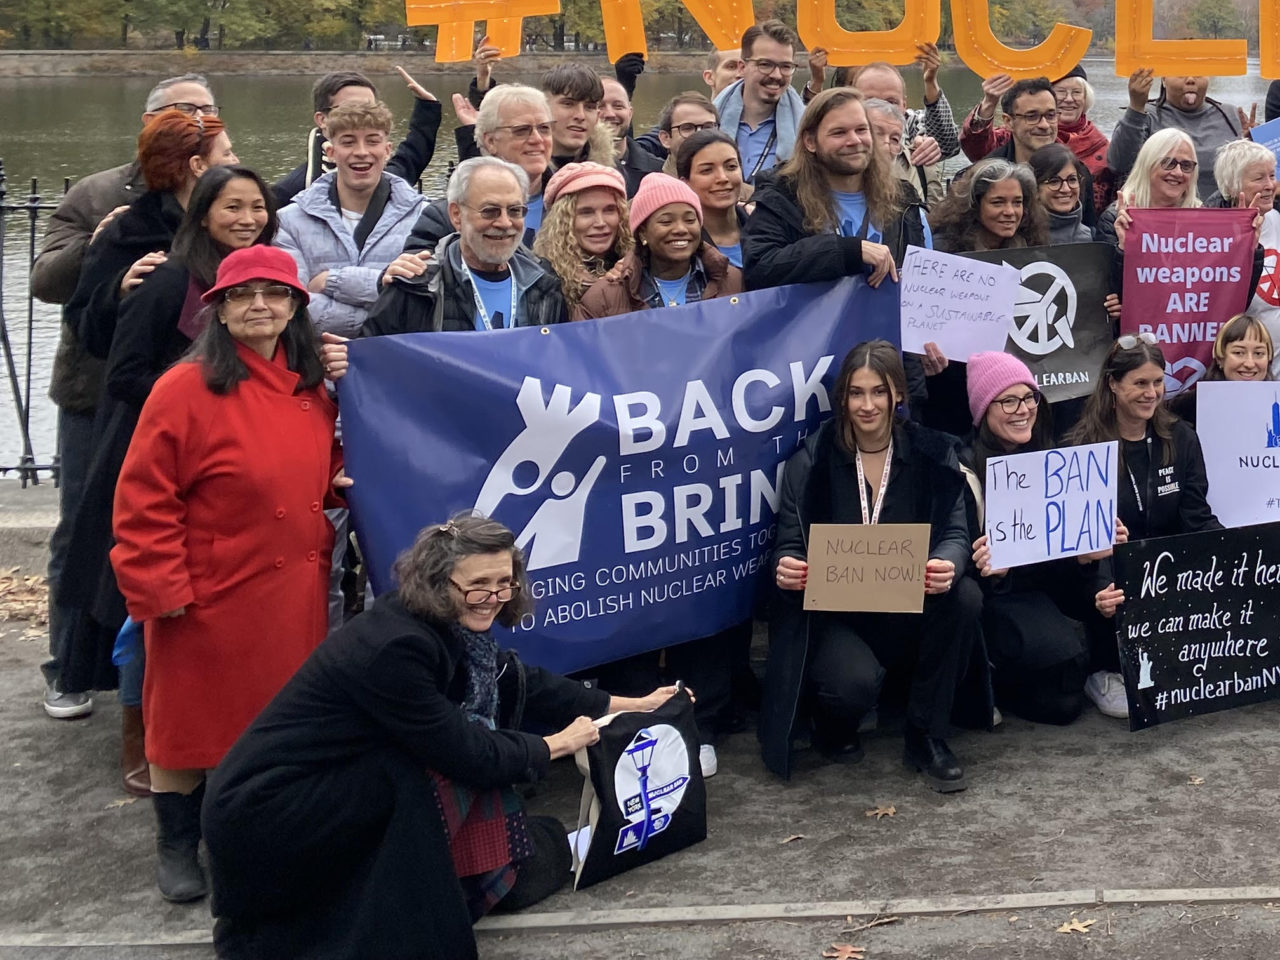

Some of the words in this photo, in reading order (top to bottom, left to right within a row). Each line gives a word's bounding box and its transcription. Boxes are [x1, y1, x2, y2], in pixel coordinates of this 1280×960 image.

[1141, 232, 1234, 254] Nuclear
[907, 250, 948, 278] THERE
[952, 269, 974, 283] ARE
[979, 274, 996, 287] NO
[1136, 264, 1241, 289] weapons
[1166, 292, 1210, 314] ARE
[1139, 321, 1224, 344] BANNE
[1035, 371, 1089, 387] LEARBAN
[613, 355, 835, 456] BACK
[620, 447, 734, 483] FROM
[773, 430, 808, 455] TH
[991, 459, 1031, 491] The
[1043, 446, 1110, 498] BAN
[621, 461, 786, 554] BRIN
[987, 520, 1007, 546] is
[1011, 510, 1037, 542] the
[1044, 498, 1114, 556] PLAN
[530, 573, 585, 599] GING
[595, 538, 741, 587] COMMUNITIES
[827, 538, 914, 558] NUCLEAR
[826, 565, 864, 584] BAN
[875, 564, 921, 582] NOW!
[1141, 551, 1174, 599] We
[1176, 555, 1224, 593] made
[1231, 552, 1249, 587] it
[544, 593, 633, 627] ABOLISH
[640, 569, 726, 607] NUCLEAR
[1127, 620, 1152, 639] we
[1158, 615, 1184, 634] can
[1188, 603, 1232, 632] make
[1239, 599, 1254, 625] it
[1178, 631, 1269, 677] anywhere
